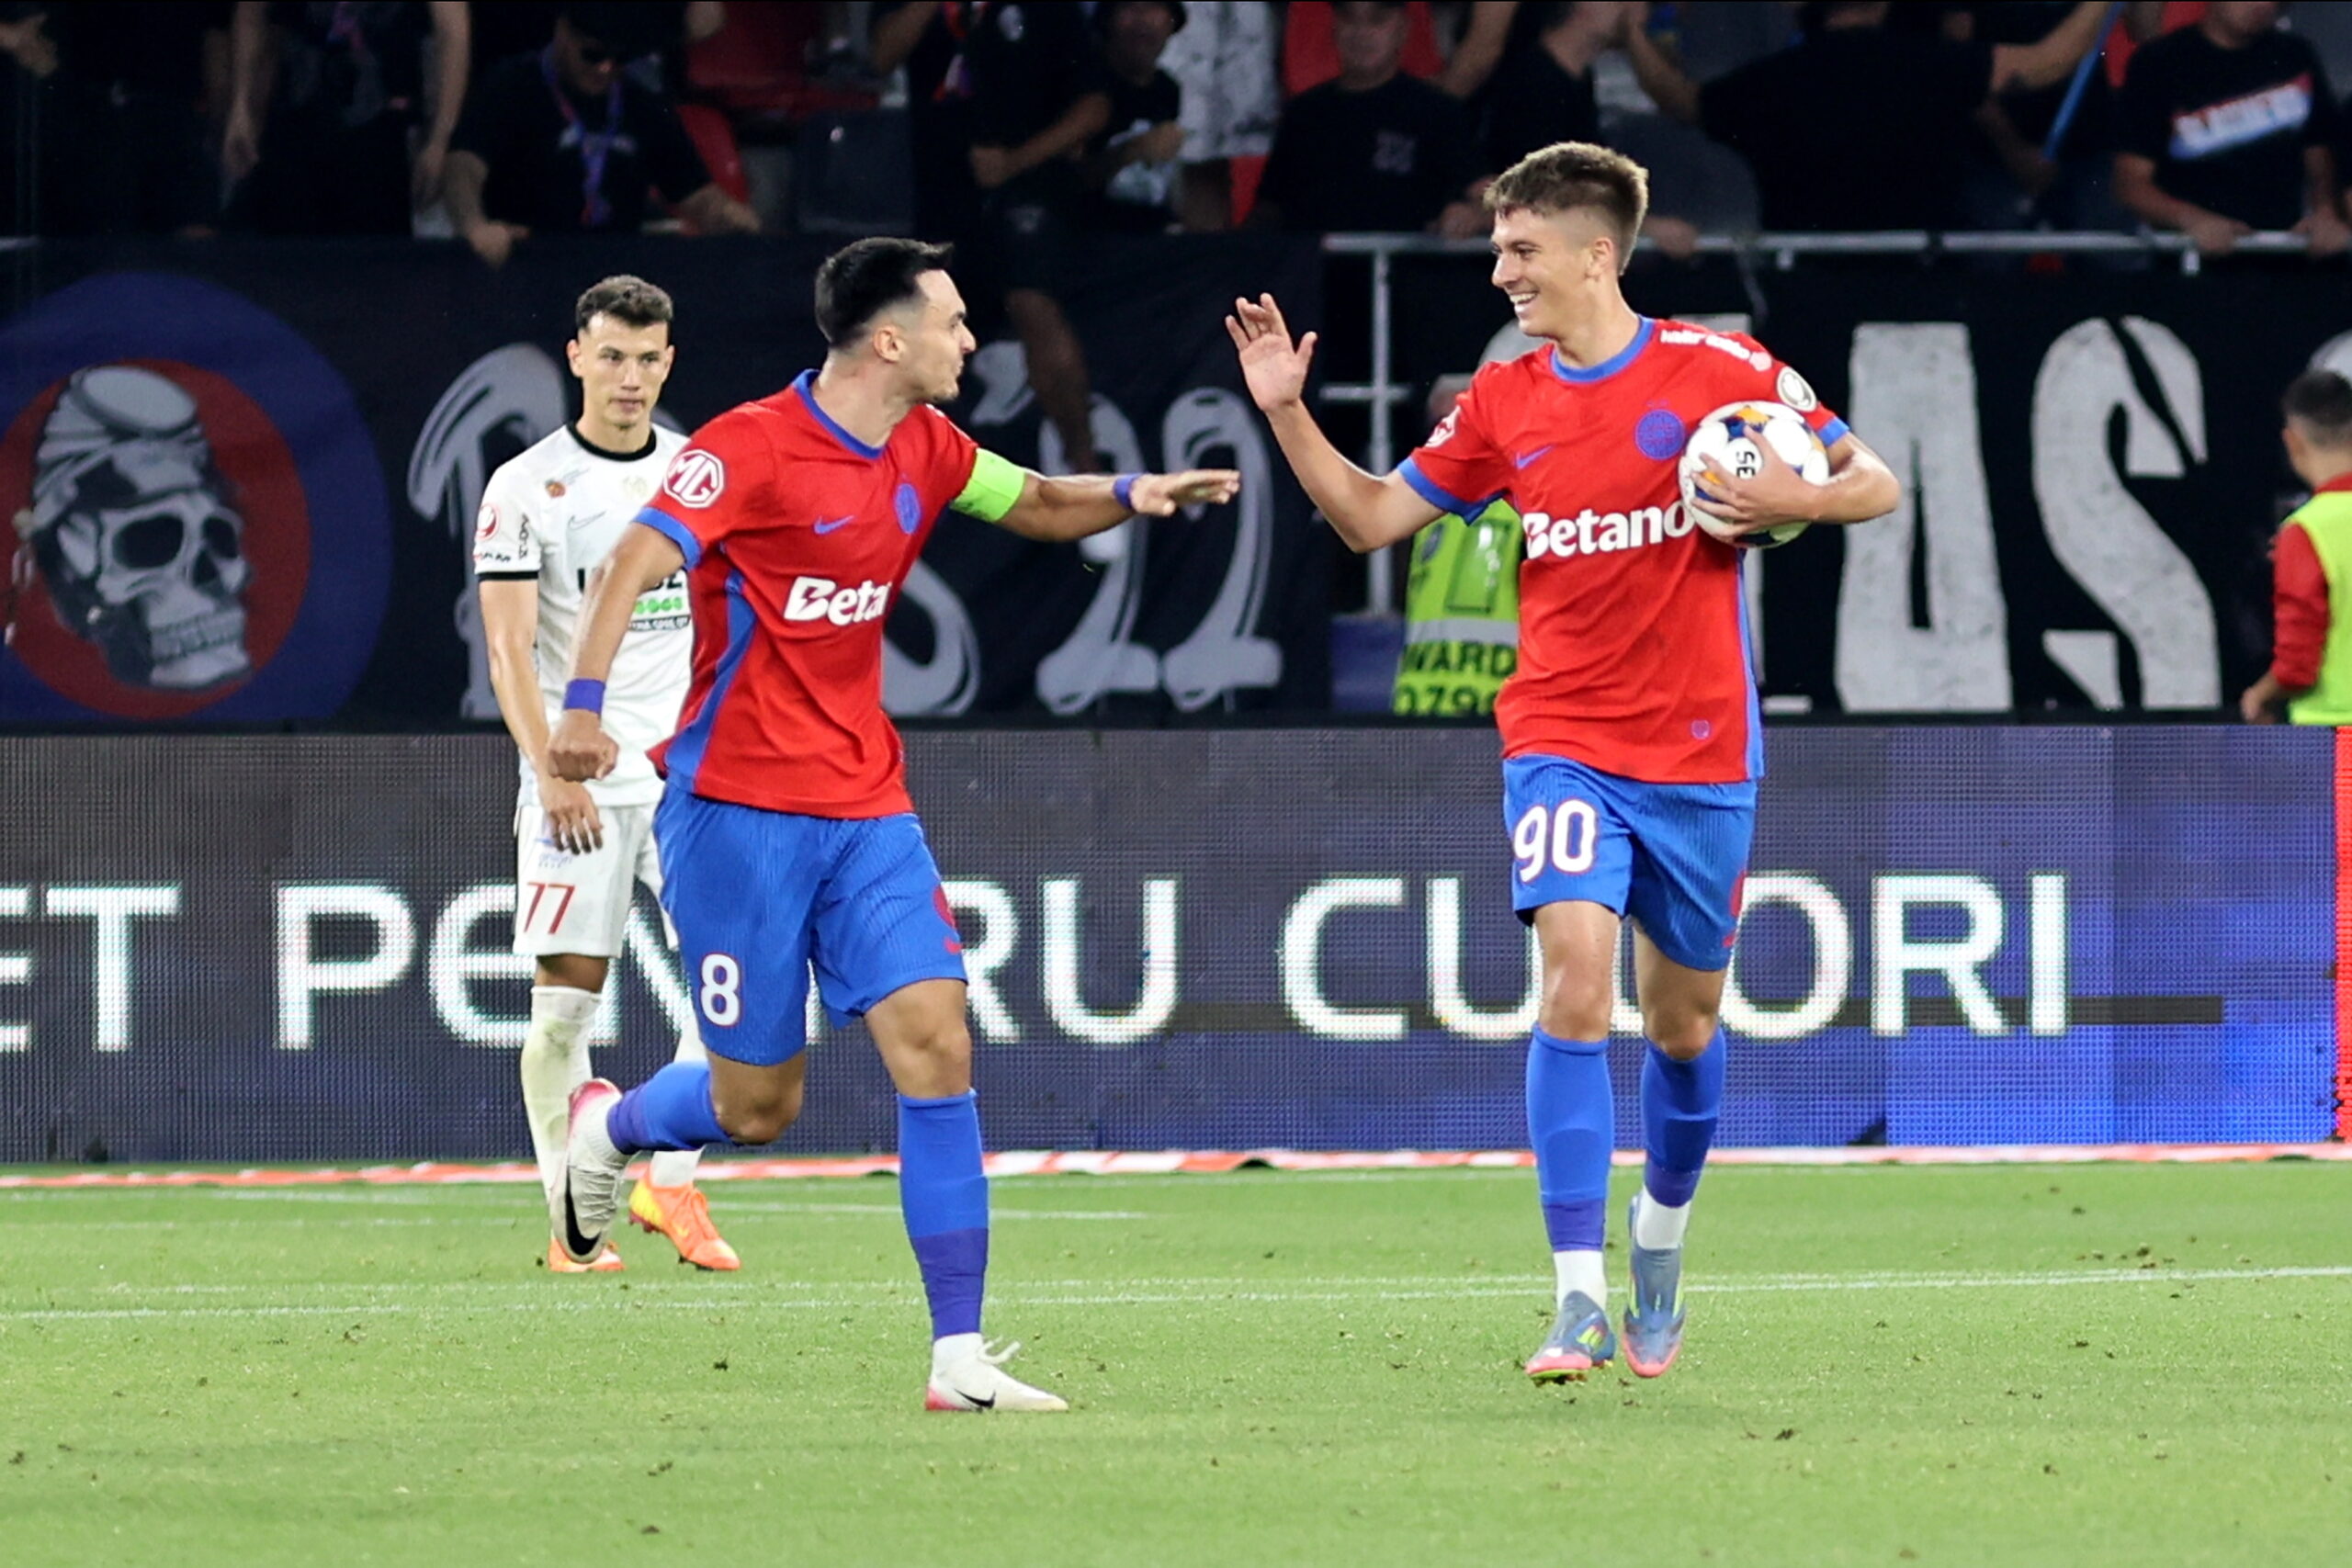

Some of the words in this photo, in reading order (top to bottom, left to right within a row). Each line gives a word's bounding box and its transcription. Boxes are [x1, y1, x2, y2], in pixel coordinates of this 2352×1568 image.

[666, 450, 722, 506] MG
[1522, 500, 1697, 560] Betano
[783, 575, 892, 626] Beta
[1513, 799, 1597, 883] 90
[524, 882, 575, 935] 77
[699, 953, 740, 1026] 8
